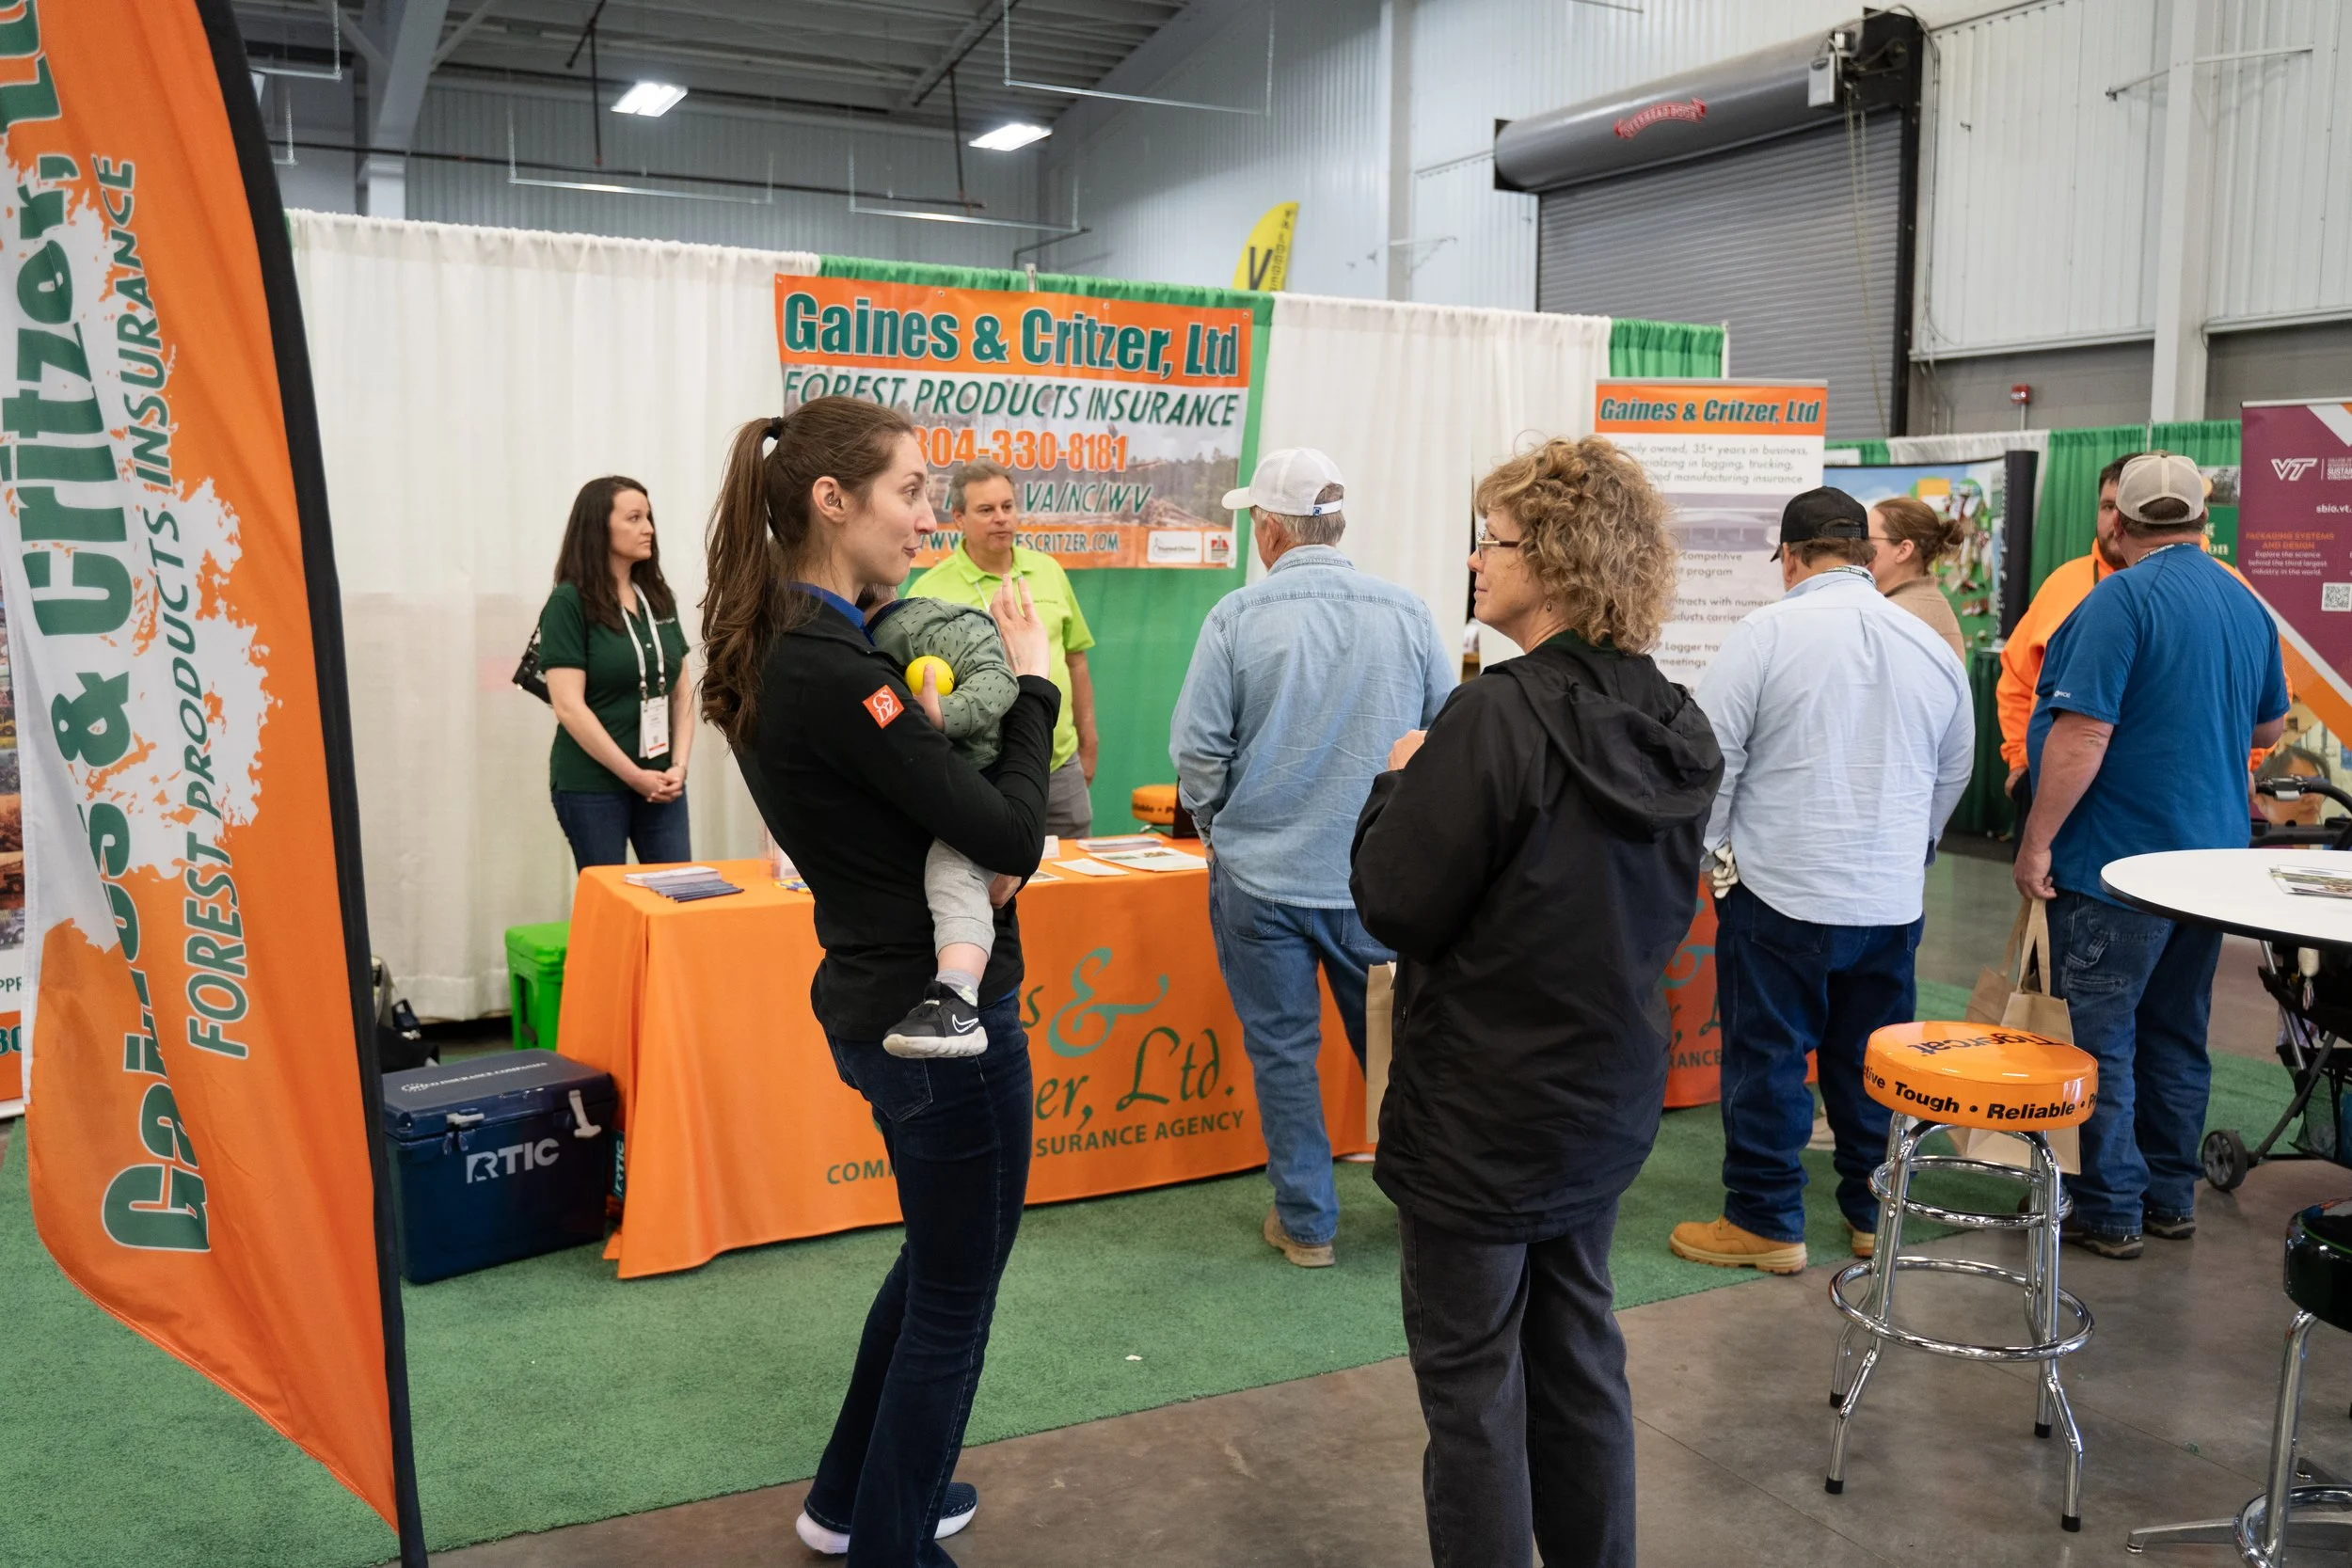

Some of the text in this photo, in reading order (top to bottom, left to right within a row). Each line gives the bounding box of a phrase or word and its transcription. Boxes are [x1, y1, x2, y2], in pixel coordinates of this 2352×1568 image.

[784, 293, 1239, 380] Gaines & Critzer, Ltd
[913, 378, 1082, 420] PRODUCTS
[1086, 387, 1239, 427] INSURANCE
[1599, 397, 1820, 425] Gaines & Critzer, Ltd
[1689, 458, 1697, 467] in
[1717, 447, 1745, 457] years
[1750, 446, 1758, 454] in
[1762, 444, 1808, 456] business,
[1675, 470, 1749, 483] manufacturing
[1753, 475, 1803, 483] insurance
[2271, 457, 2318, 482] VT
[91, 152, 249, 1060] FOREST PRODUCTS INSURANCE
[1709, 597, 1731, 607] with
[1665, 643, 1701, 654] Logger
[52, 672, 131, 768] &
[1047, 947, 1169, 1058] &
[1116, 1026, 1234, 1112] Ltd.
[1895, 1081, 1959, 1114] Tough
[1987, 1101, 2075, 1119] Reliable
[1154, 1110, 1244, 1141] AGENCY
[466, 1138, 560, 1184] RTIC
